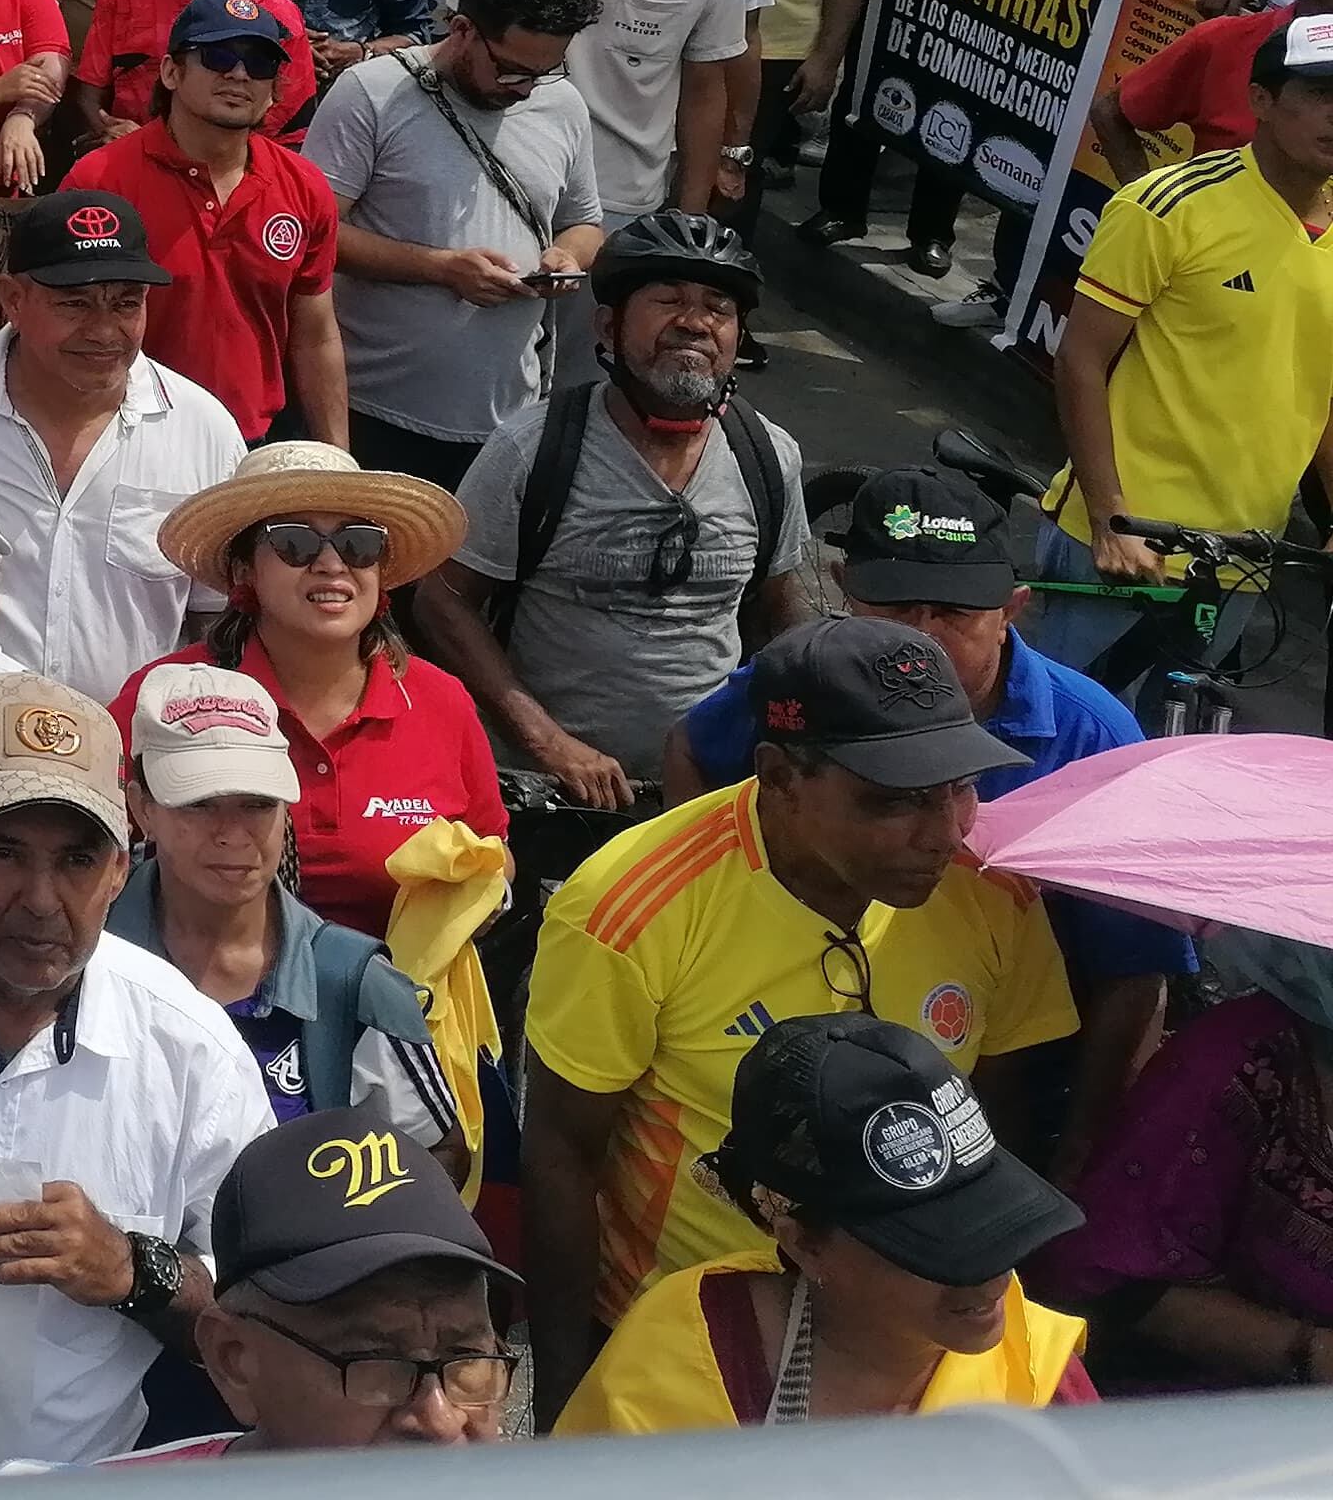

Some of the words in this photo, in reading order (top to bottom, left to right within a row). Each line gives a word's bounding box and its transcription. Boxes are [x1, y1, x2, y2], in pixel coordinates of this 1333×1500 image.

[948, 9, 1015, 65] GRANDES
[1014, 41, 1077, 95] MEDIOS
[886, 16, 917, 60] DE
[917, 31, 1067, 137] COMUNICACION
[979, 144, 1044, 193] Semana
[75, 238, 122, 250] TOYOTA
[921, 513, 976, 532] Lotería
[937, 530, 977, 543] Cauca
[881, 1116, 920, 1142] GRUPO
